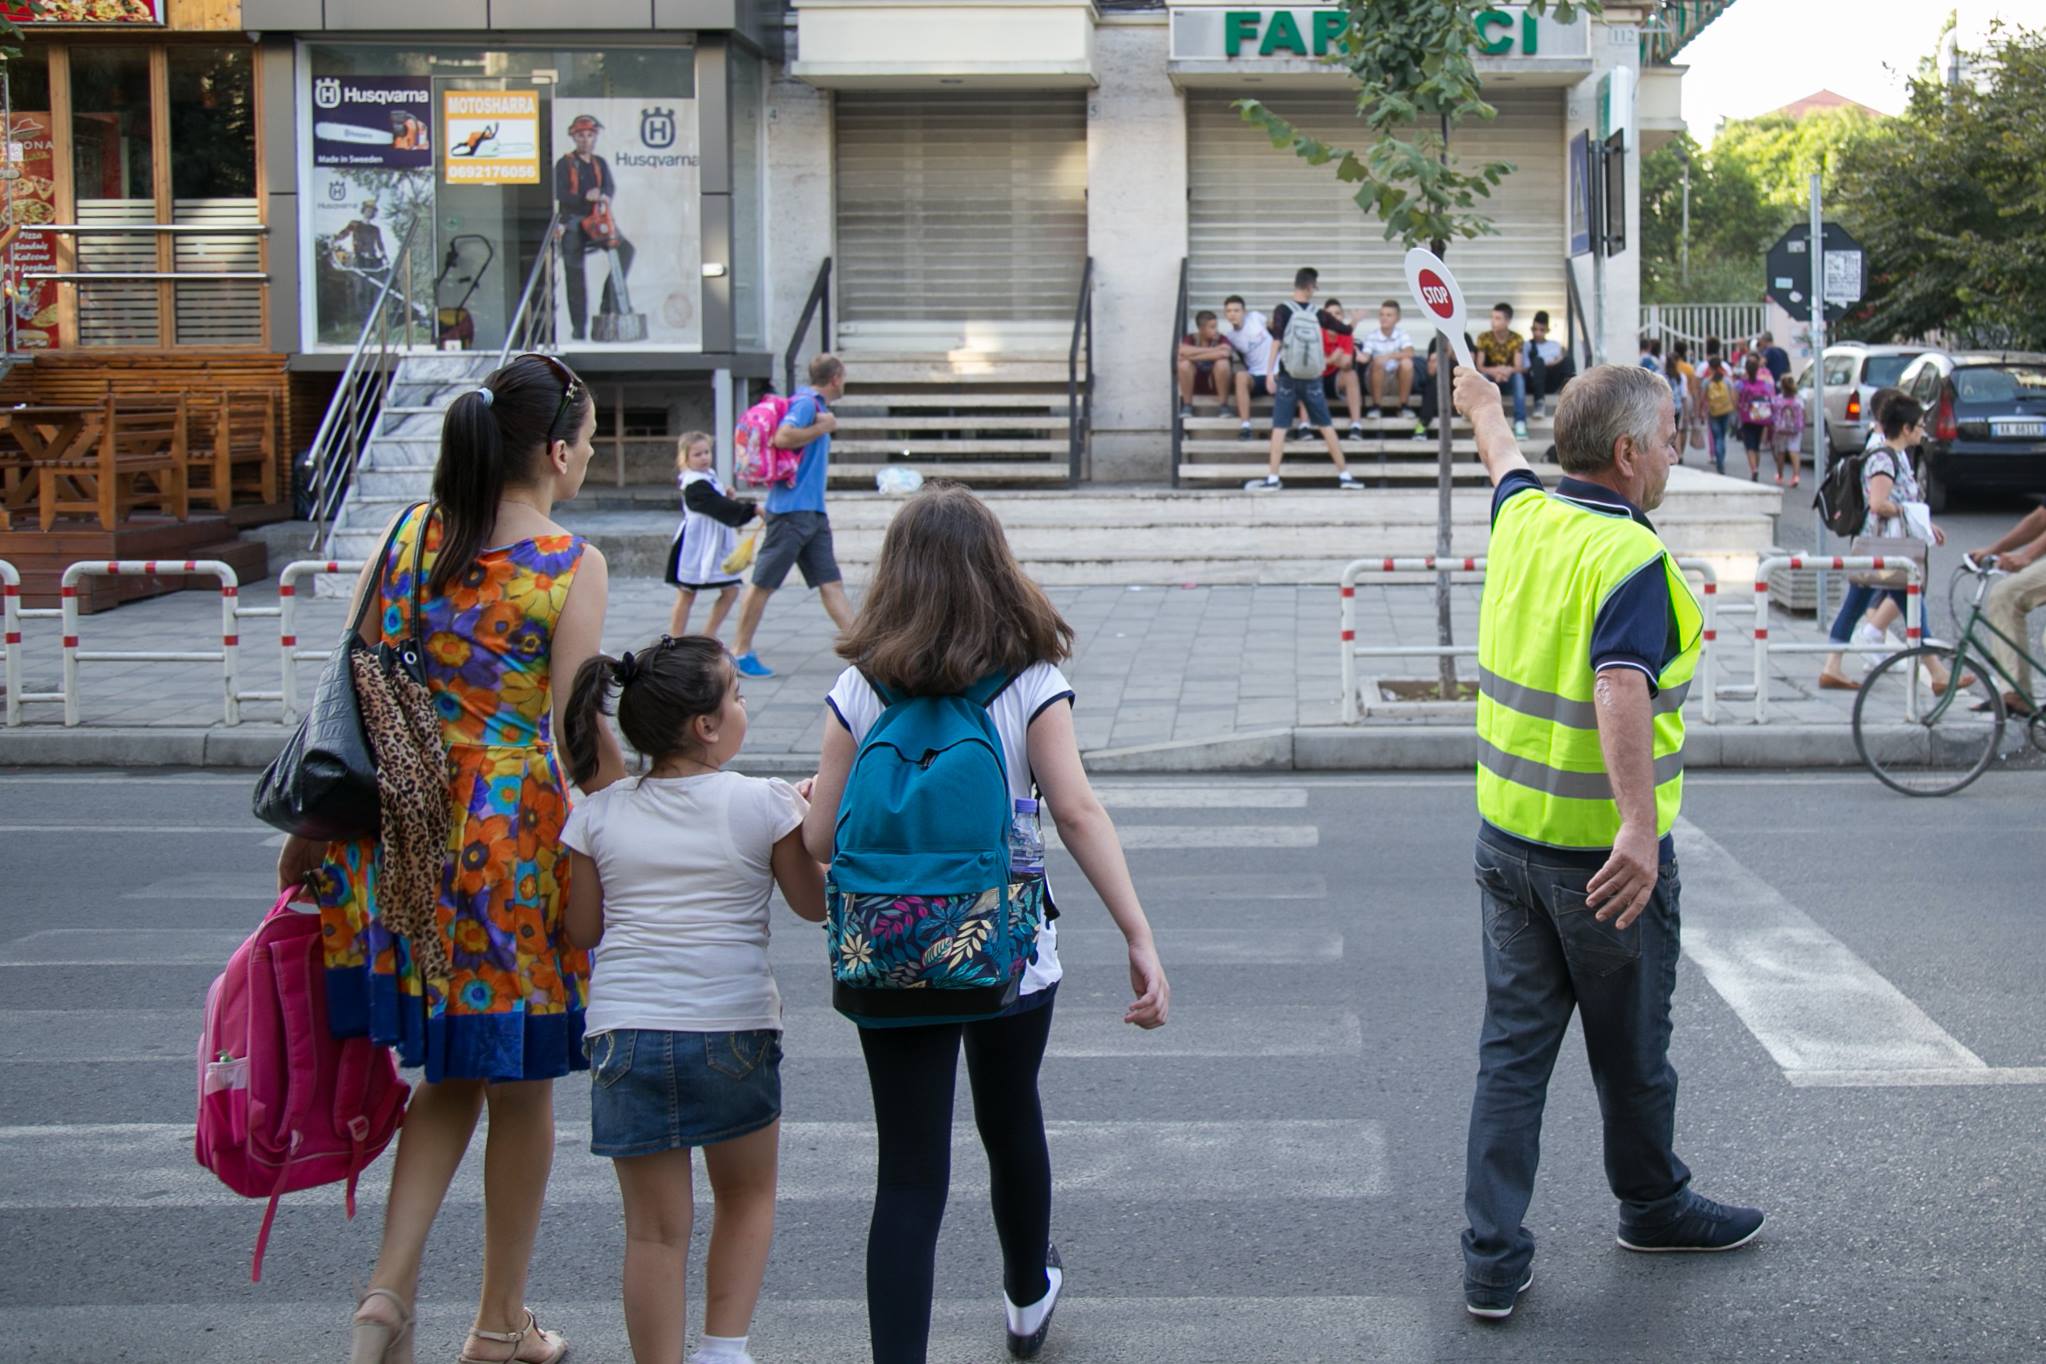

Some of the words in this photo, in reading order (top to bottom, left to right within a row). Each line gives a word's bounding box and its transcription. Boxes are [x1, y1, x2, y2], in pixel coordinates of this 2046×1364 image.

[1225, 11, 1538, 57] FARCI
[1613, 29, 1634, 42] 112
[344, 87, 429, 104] Husqvarna
[448, 96, 536, 114] MOTOSHARRA
[318, 155, 339, 163] Made
[341, 155, 348, 163] in
[615, 152, 700, 169] Husqvarna
[1423, 286, 1449, 305] STOP
